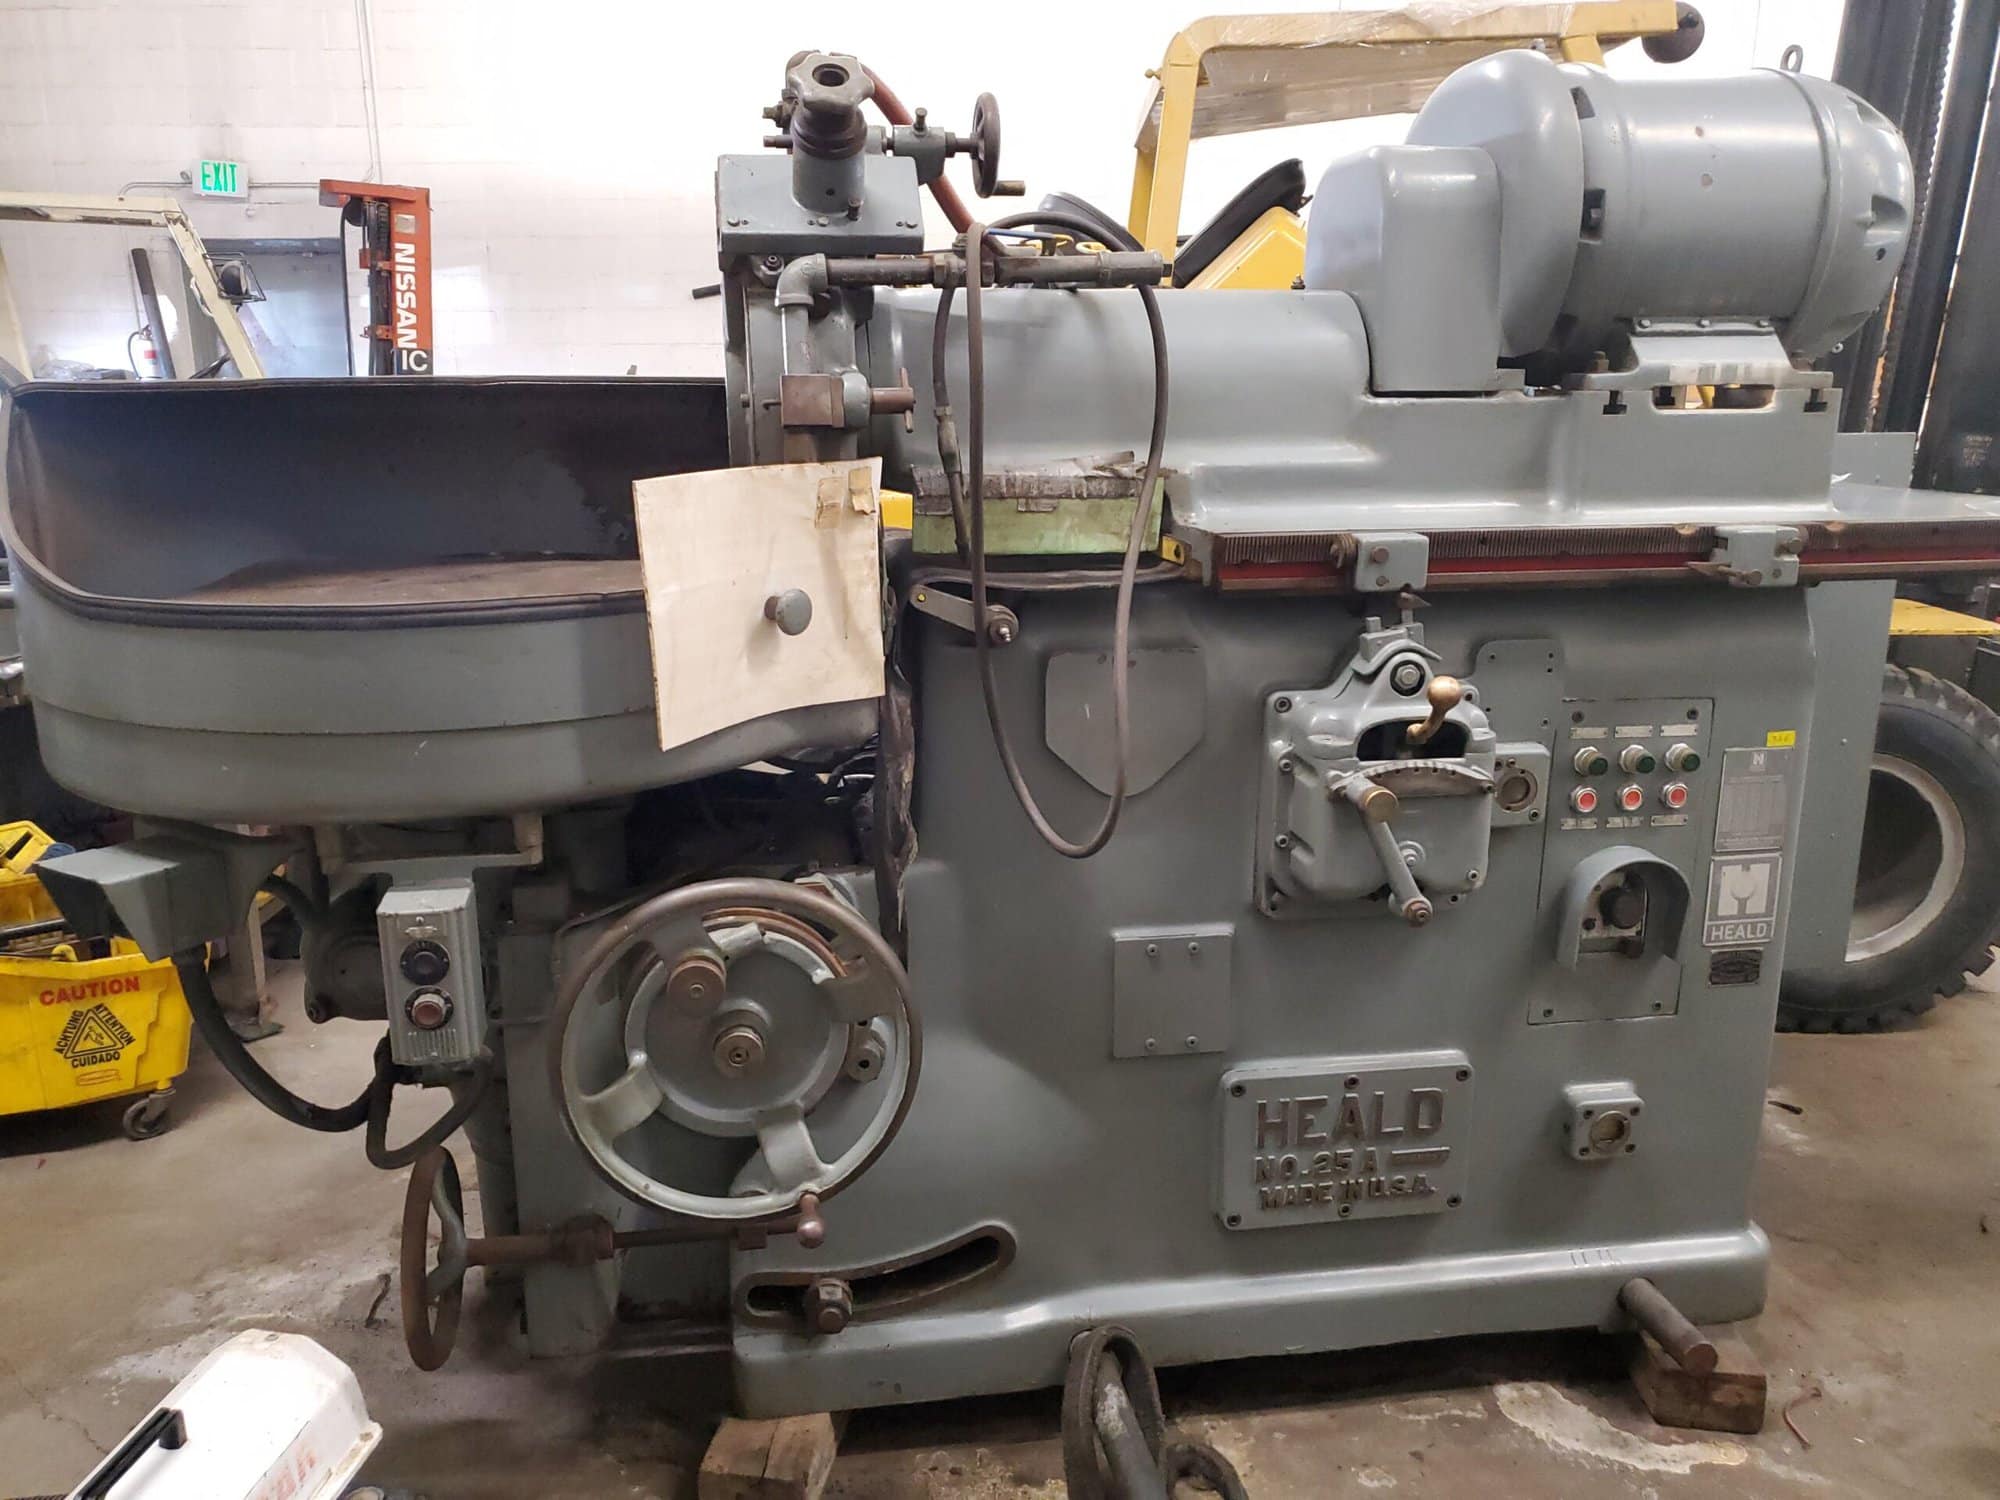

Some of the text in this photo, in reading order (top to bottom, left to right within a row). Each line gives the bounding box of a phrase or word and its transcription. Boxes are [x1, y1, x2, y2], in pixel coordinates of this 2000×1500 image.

[201, 161, 237, 193] EXIT
[394, 242, 417, 348] NISSAN
[1711, 922, 1768, 941] HEALD
[39, 976, 140, 1006] CAUTION
[54, 1009, 85, 1055] ACHTUNG
[93, 1003, 136, 1046] ATTENTION
[71, 1051, 121, 1069] CUIDADO
[1256, 1087, 1446, 1149] HEALD
[1259, 1182, 1334, 1211] MADE
[1340, 1178, 1364, 1203] IN
